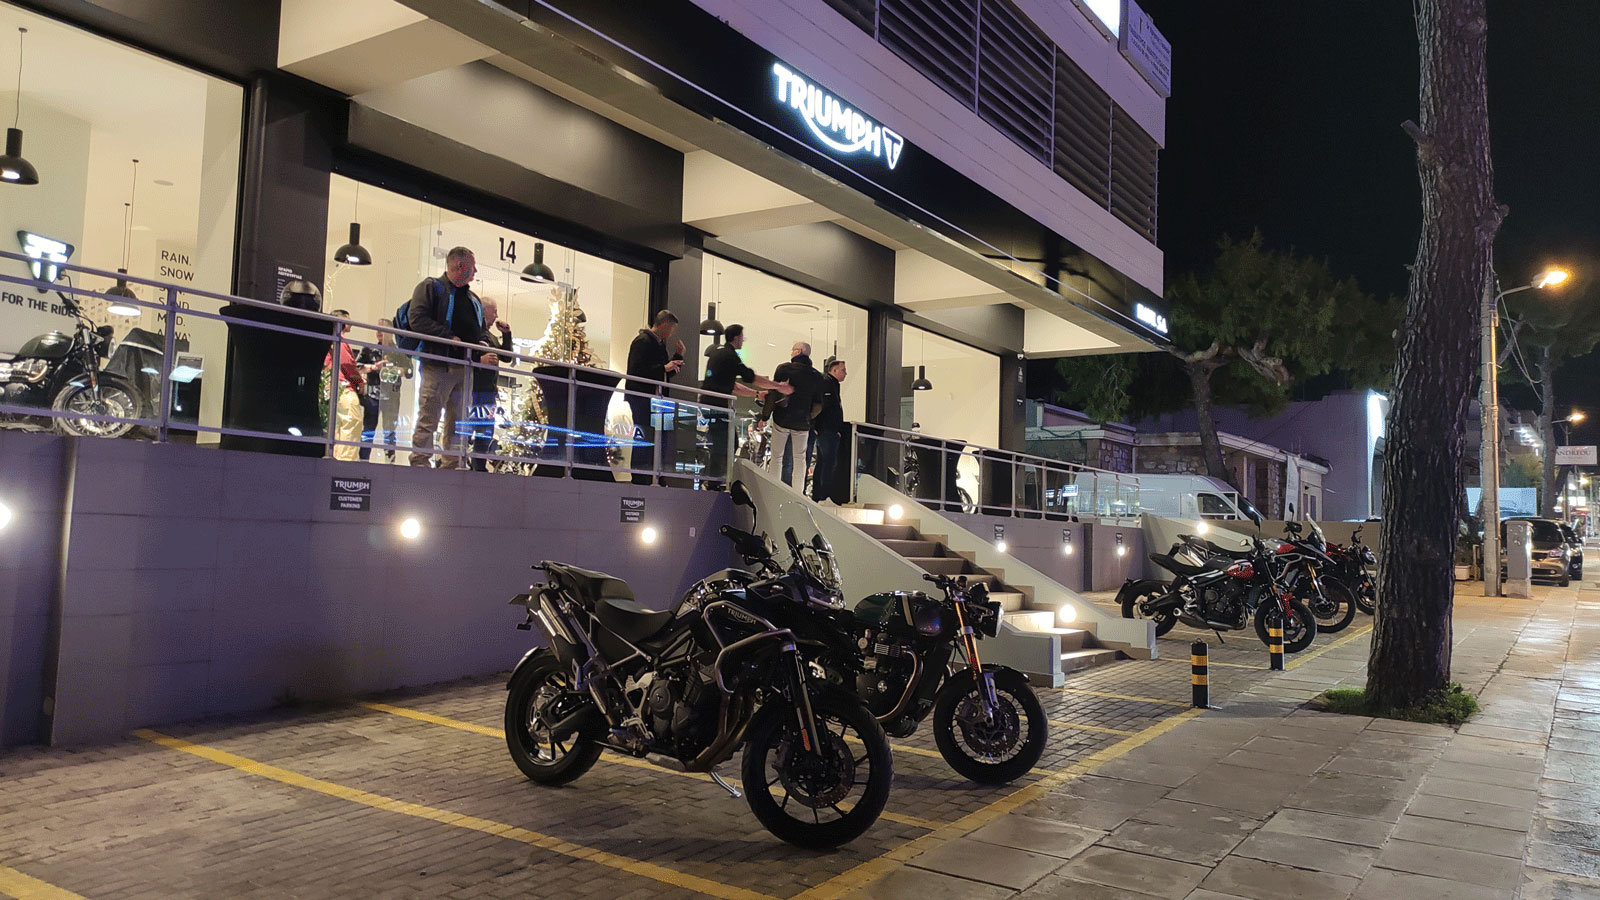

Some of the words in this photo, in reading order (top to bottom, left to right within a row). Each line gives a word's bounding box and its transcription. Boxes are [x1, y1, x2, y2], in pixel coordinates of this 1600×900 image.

[773, 63, 881, 157] TRIUMPH
[160, 250, 192, 266] RAIN.
[498, 236, 517, 264] 14
[159, 266, 194, 281] SNOW
[1, 291, 24, 306] FOR
[27, 297, 49, 312] THE
[157, 312, 186, 327] MD.
[334, 480, 370, 492] TRIUMPH
[622, 499, 644, 508] TRIUMPH
[727, 607, 757, 625] TRIUMPH
